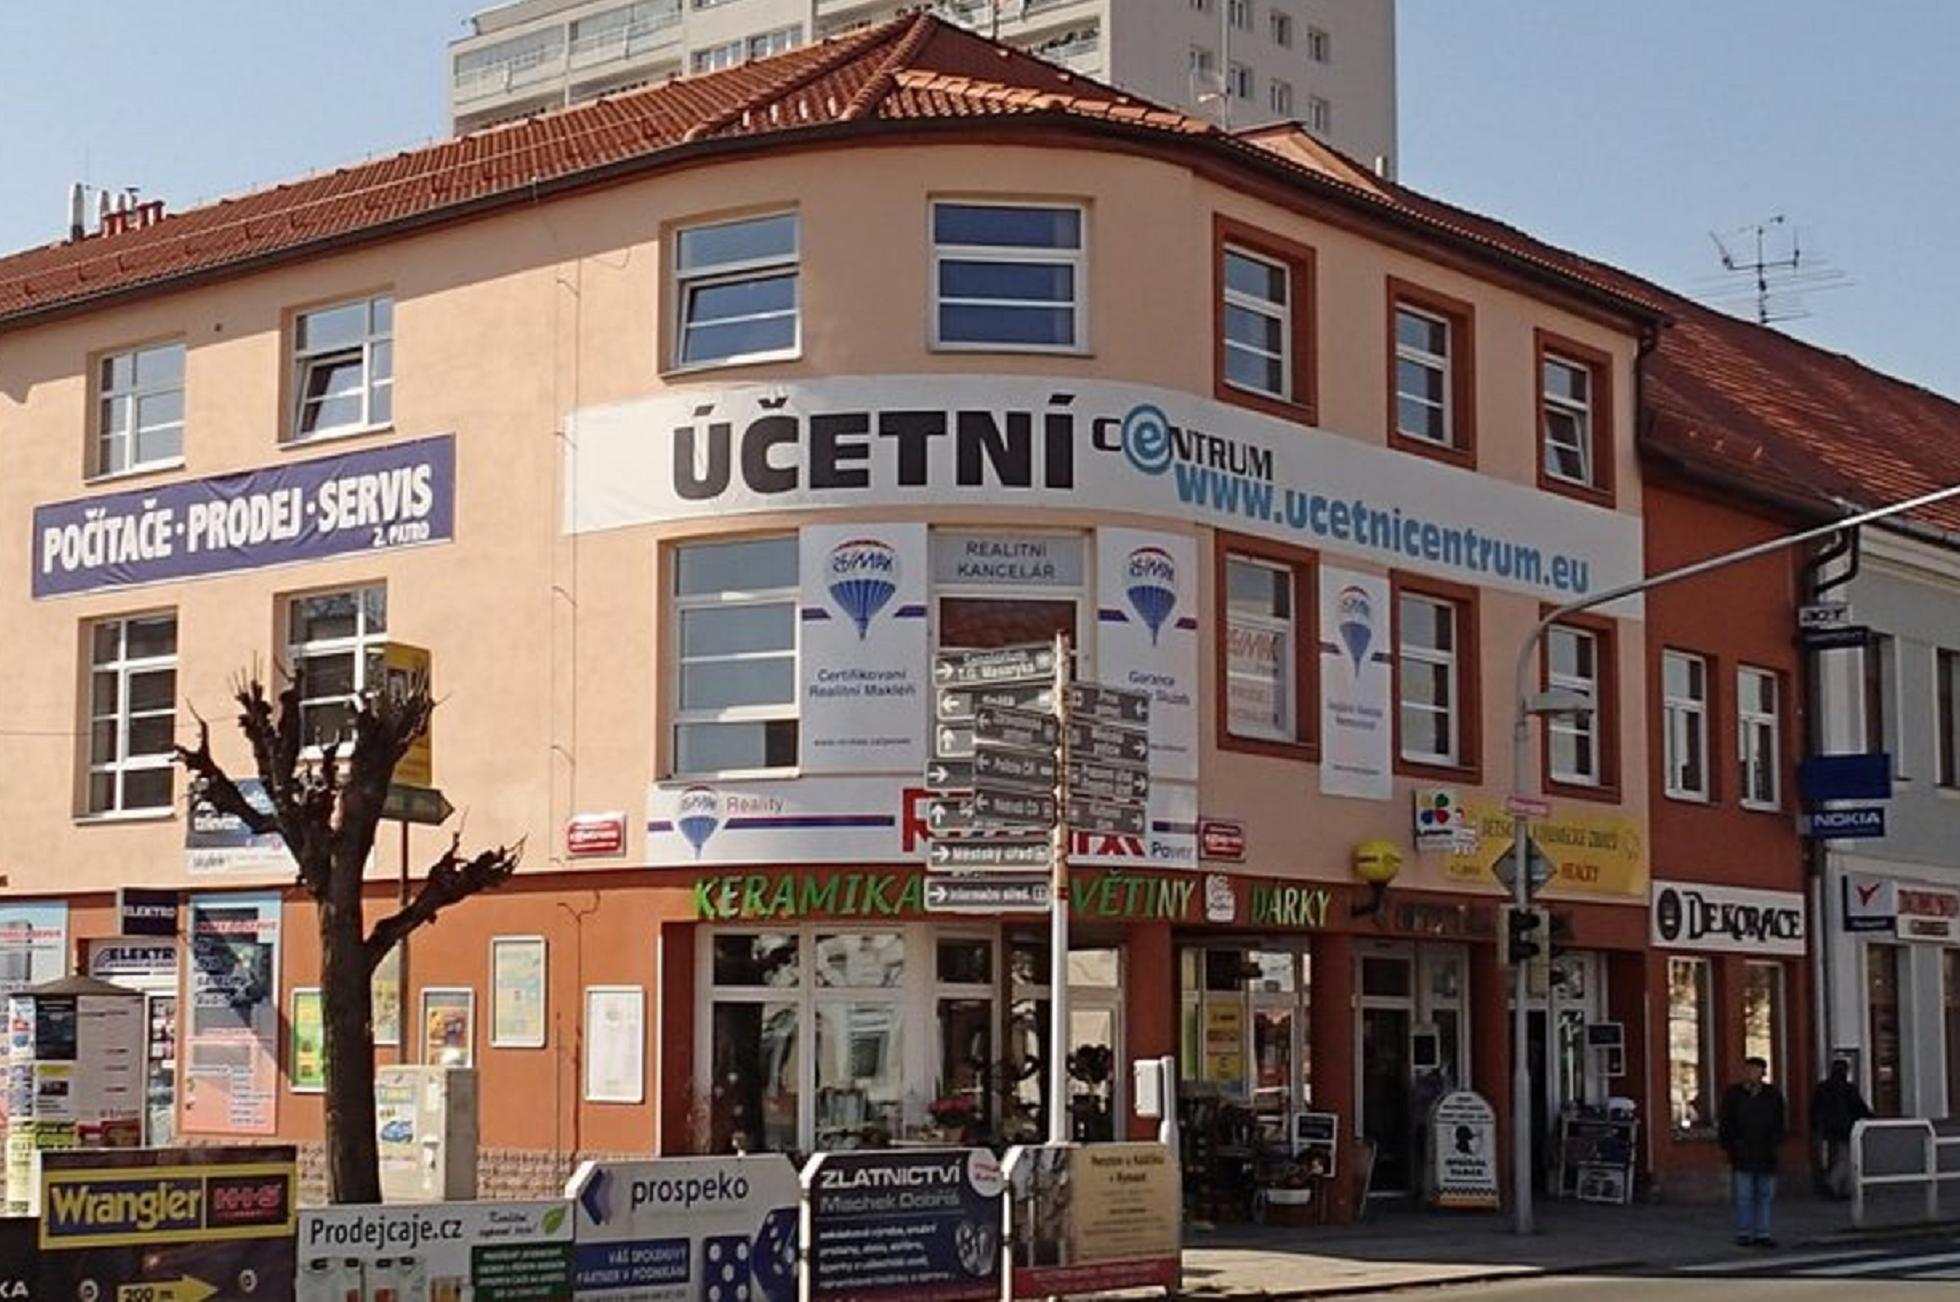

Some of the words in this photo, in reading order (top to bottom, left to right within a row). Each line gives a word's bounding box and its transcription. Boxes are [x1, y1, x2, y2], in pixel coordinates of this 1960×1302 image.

[673, 394, 1075, 500] ÚČETNÍ
[43, 498, 174, 574] POČÍTAČE
[187, 487, 303, 552] PRODEJ
[317, 463, 433, 533] SERVIS
[1174, 463, 1589, 594] www.ucetnicentrum.eu
[726, 796, 785, 812] Reality
[1813, 812, 1880, 829] NOKIA
[694, 872, 924, 920] KERAMIKA
[1071, 867, 1196, 921] VĚTINY
[109, 947, 178, 960] ELEKTR
[631, 1168, 750, 1213] prospeko
[821, 1158, 962, 1188] ZLATNICTVÍ
[51, 1182, 201, 1230] Wrangler
[310, 1214, 462, 1250] Prodejcaje.cz
